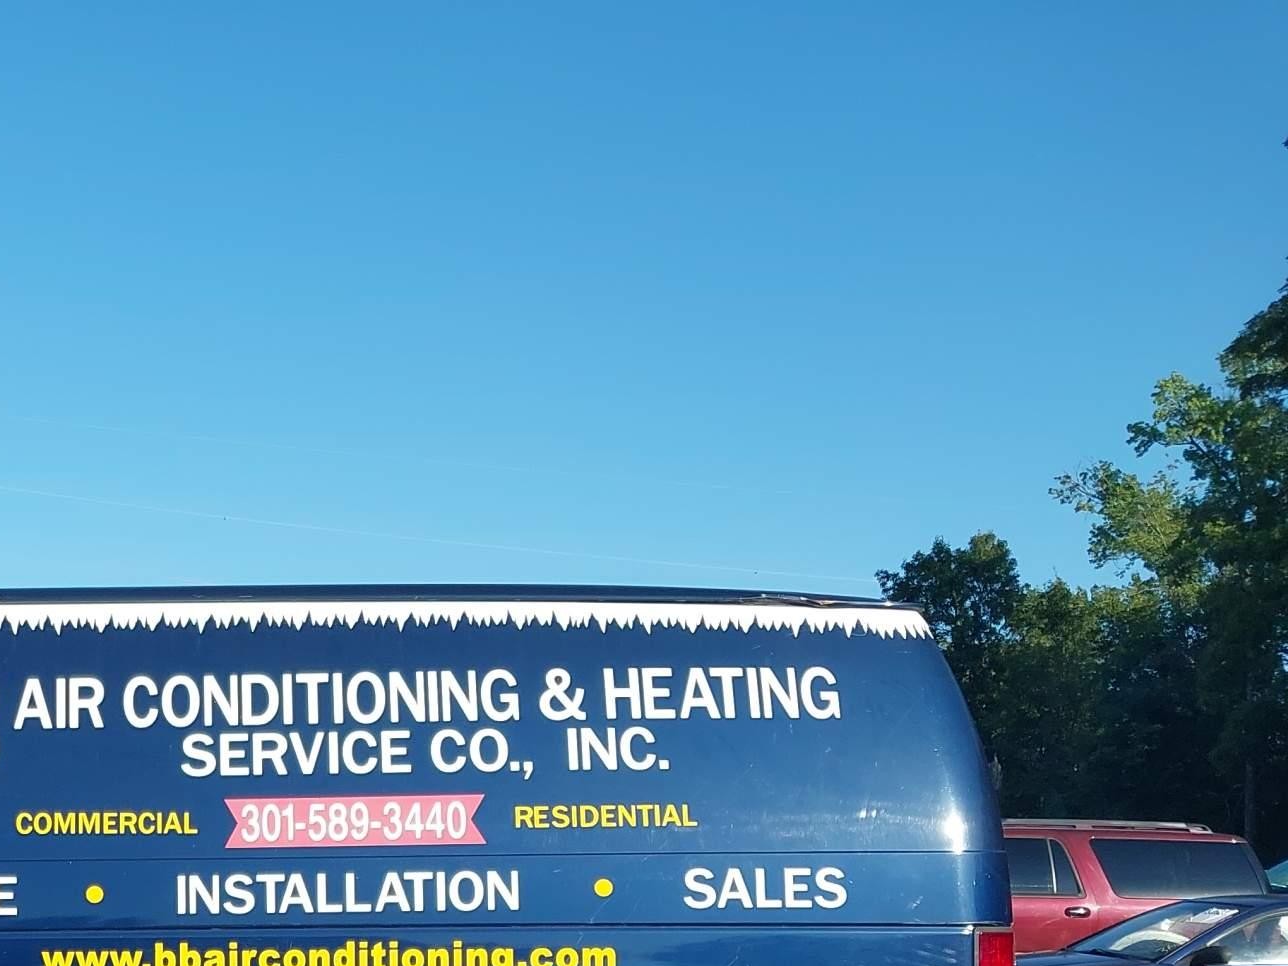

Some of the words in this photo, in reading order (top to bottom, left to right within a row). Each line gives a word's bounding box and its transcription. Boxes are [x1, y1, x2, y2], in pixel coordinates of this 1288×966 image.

[13, 677, 105, 730] AIR
[123, 669, 520, 728] CONDITIONING
[540, 667, 587, 721] &
[603, 666, 842, 721] HEATING
[181, 730, 412, 777] SERVICE
[430, 728, 534, 780] CO.,
[567, 727, 671, 771] INC.
[15, 811, 198, 835] COMMERCIAL
[240, 800, 467, 843] 301-589-3440
[514, 804, 698, 828] RESIDENTIAL
[176, 871, 520, 915] INSTALLATION
[683, 867, 848, 909] SALES
